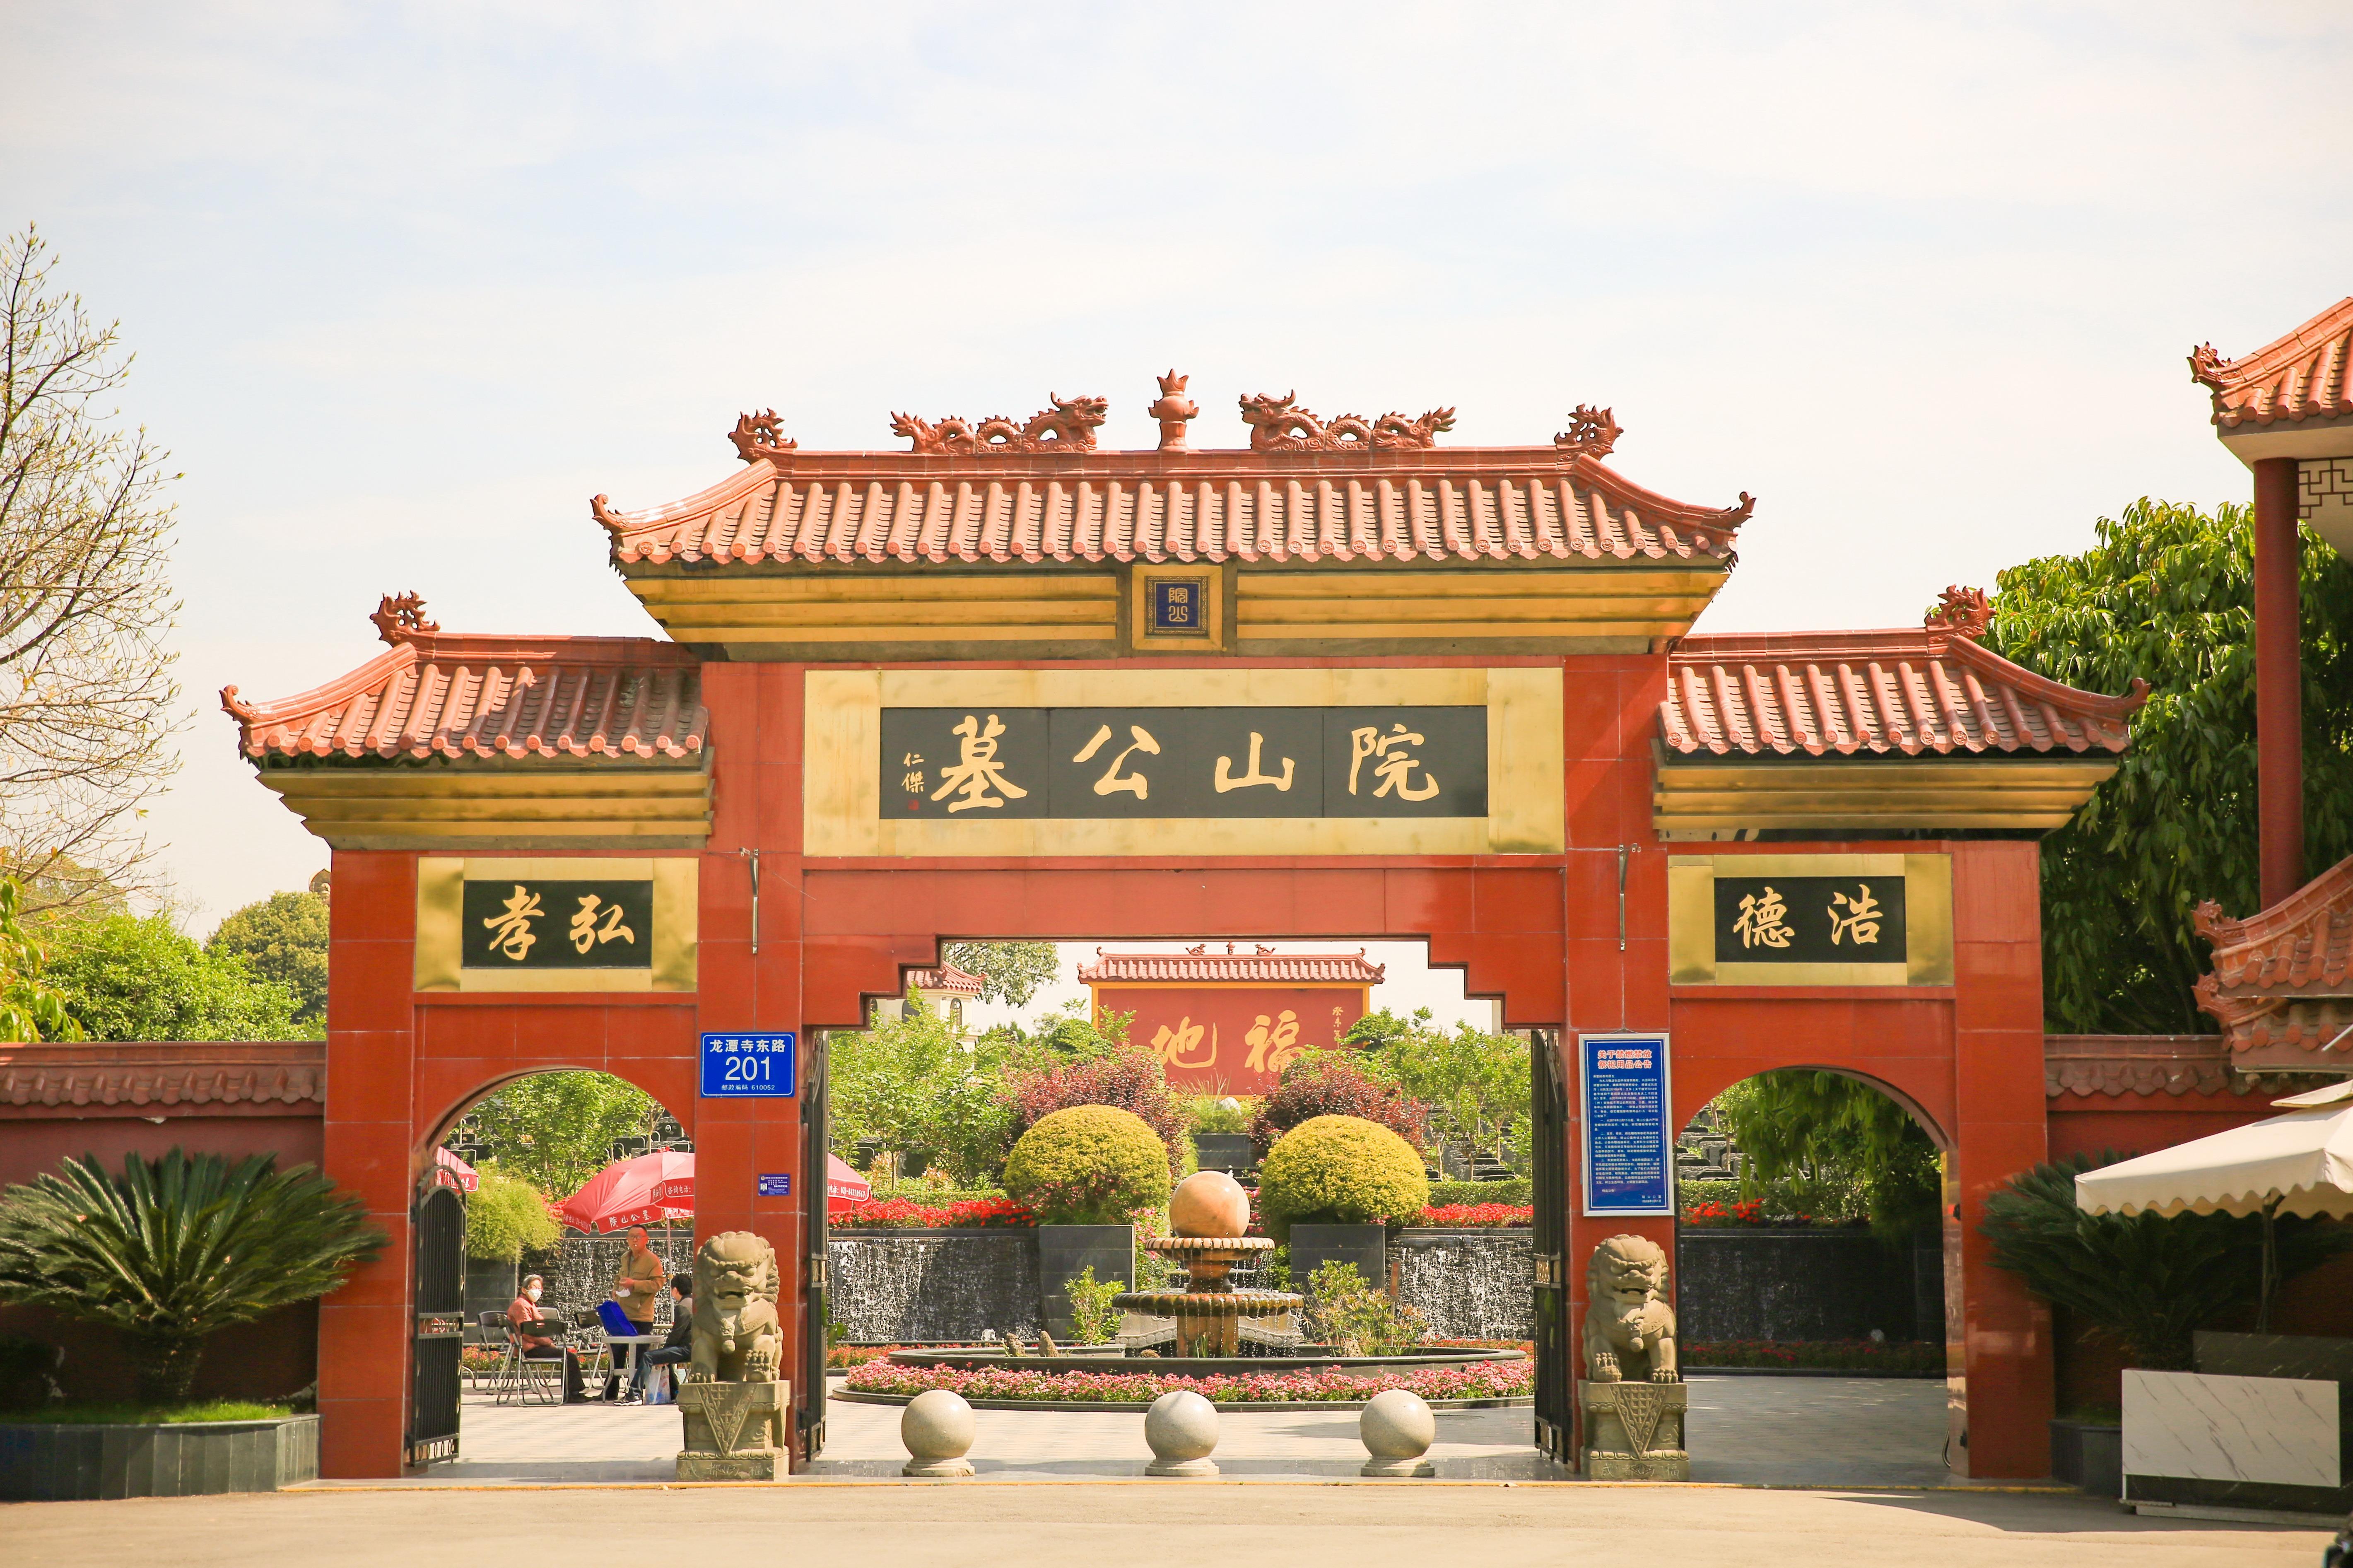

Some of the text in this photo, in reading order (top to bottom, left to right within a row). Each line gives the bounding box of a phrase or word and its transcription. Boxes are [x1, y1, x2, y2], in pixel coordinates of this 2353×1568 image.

[710, 1039, 786, 1052] 龙潭寺东路
[1598, 1049, 1652, 1059] 关于禁燃禁放
[725, 1057, 769, 1081] 201
[1598, 1059, 1652, 1069] 祭祀用品公告
[609, 1210, 651, 1228] 院山公墓
